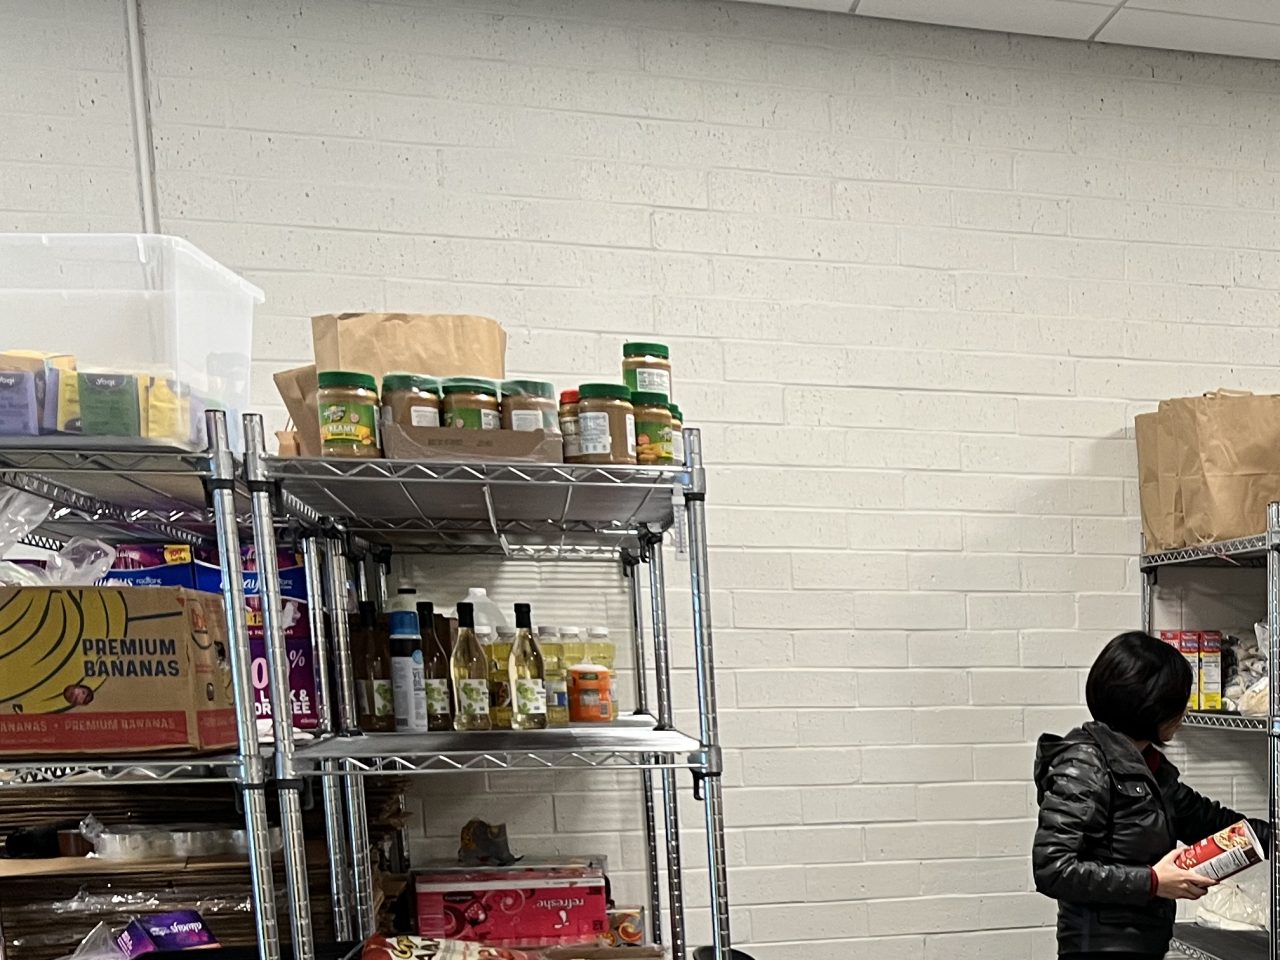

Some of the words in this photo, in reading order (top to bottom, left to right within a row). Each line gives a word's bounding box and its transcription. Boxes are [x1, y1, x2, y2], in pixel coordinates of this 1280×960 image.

[82, 638, 176, 657] PREMIUM
[83, 660, 180, 678] BANANAS
[64, 719, 119, 732] PREMIUM
[120, 717, 176, 730] BANANAS
[536, 897, 585, 910] refreshe
